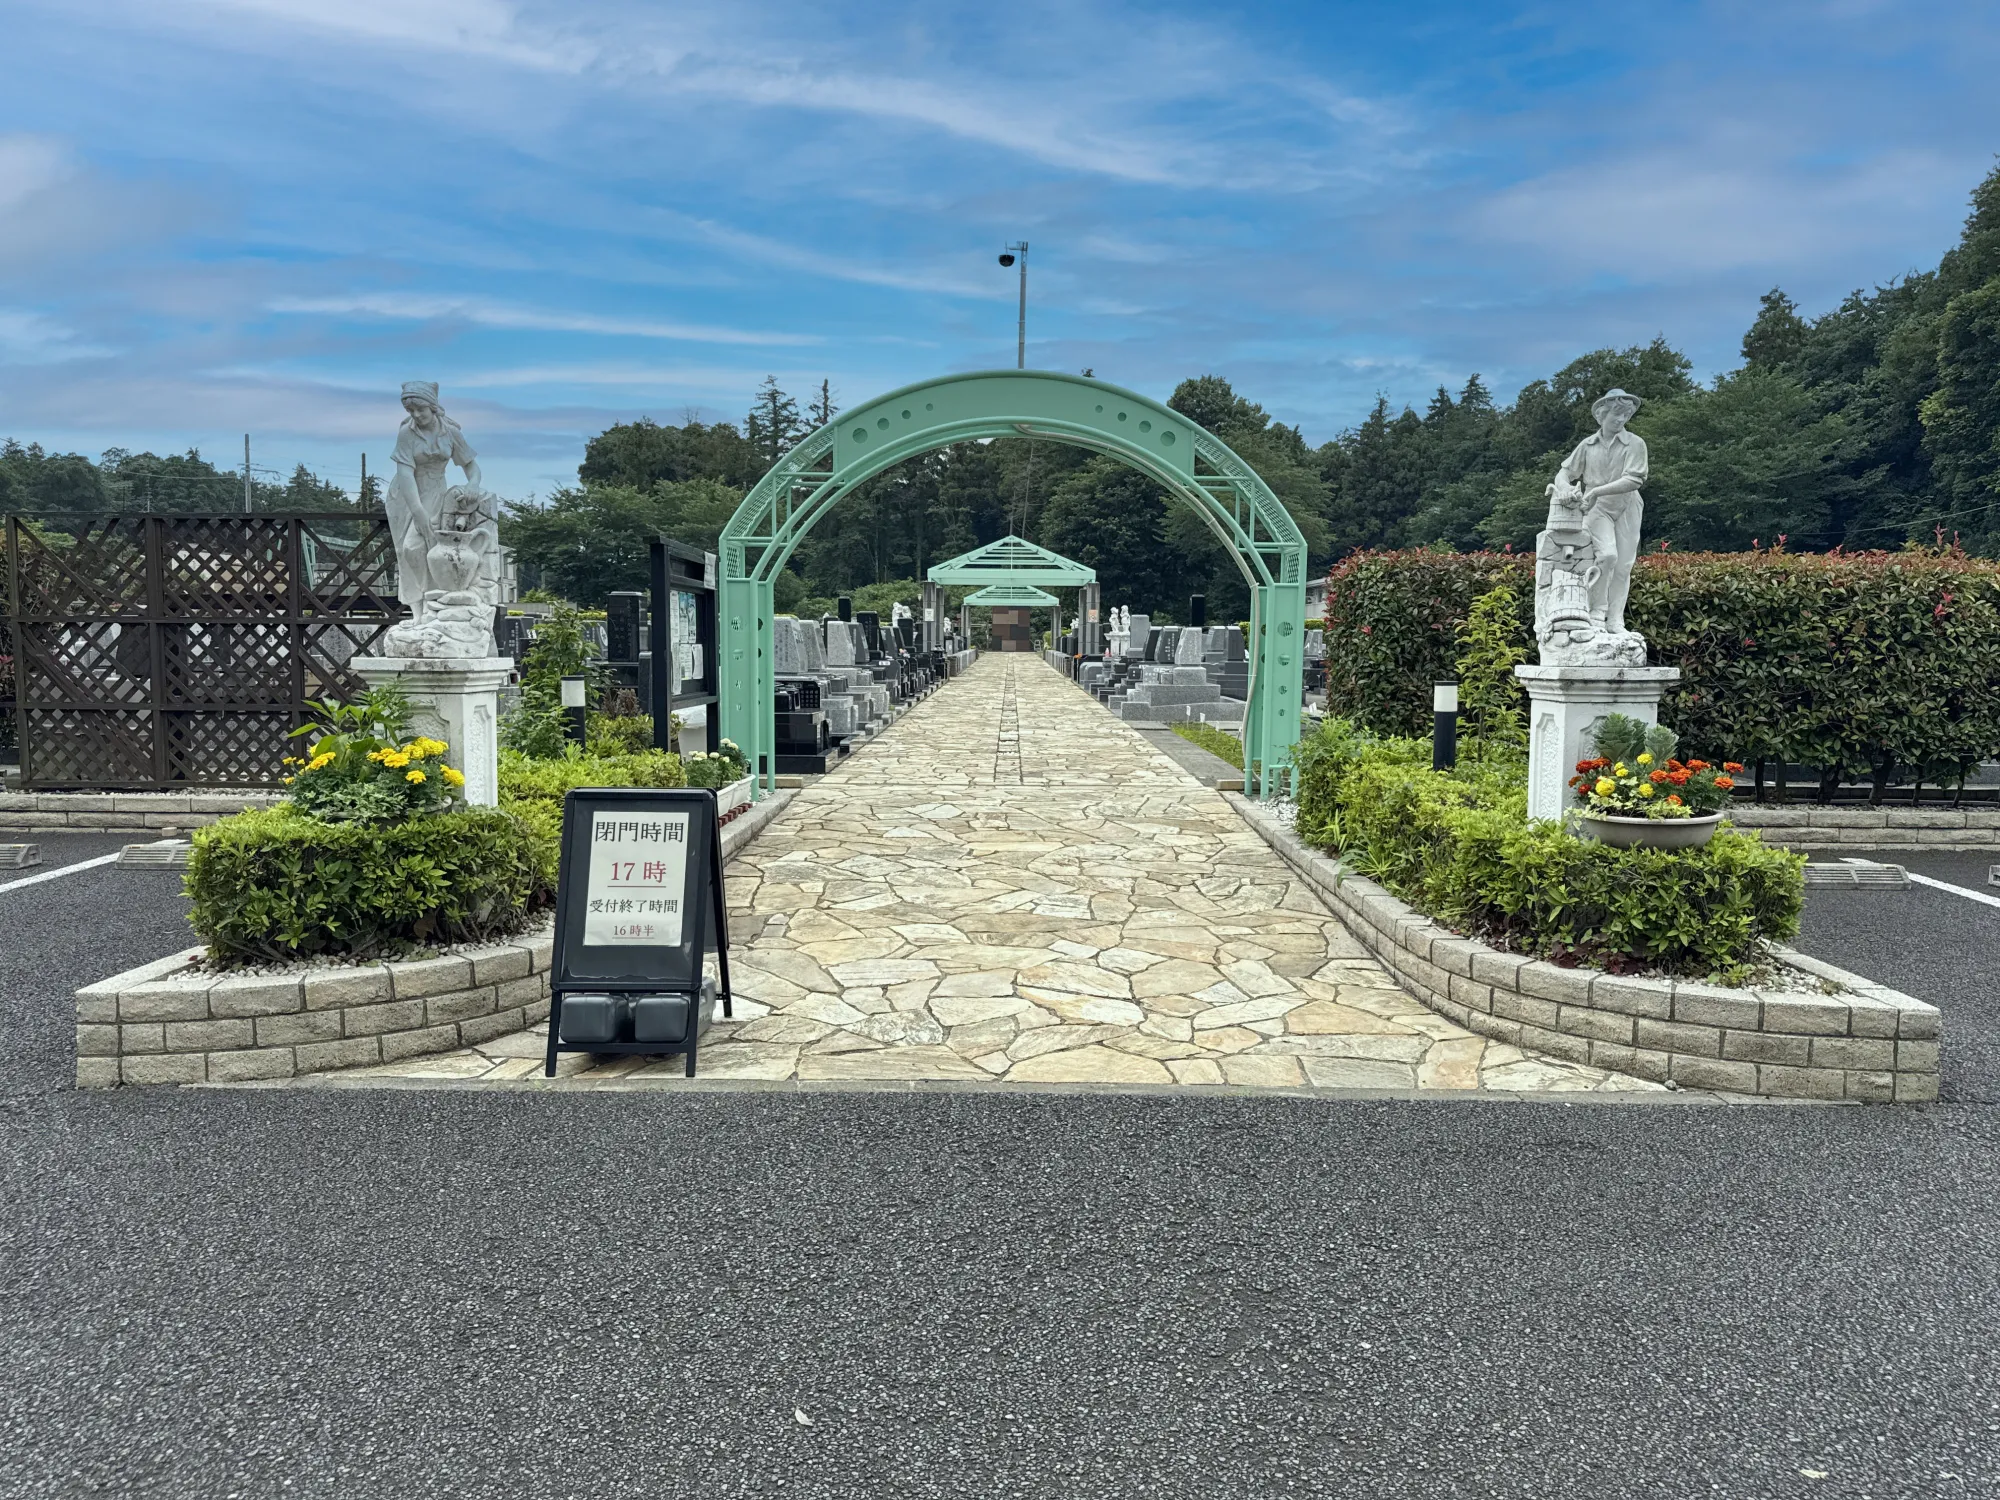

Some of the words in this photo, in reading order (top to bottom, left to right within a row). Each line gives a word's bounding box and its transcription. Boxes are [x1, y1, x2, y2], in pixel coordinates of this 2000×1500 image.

[595, 821, 684, 843] 閉門時間
[610, 861, 667, 883] 17時
[589, 899, 678, 914] 受付終了時間
[613, 924, 655, 937] 16時半
